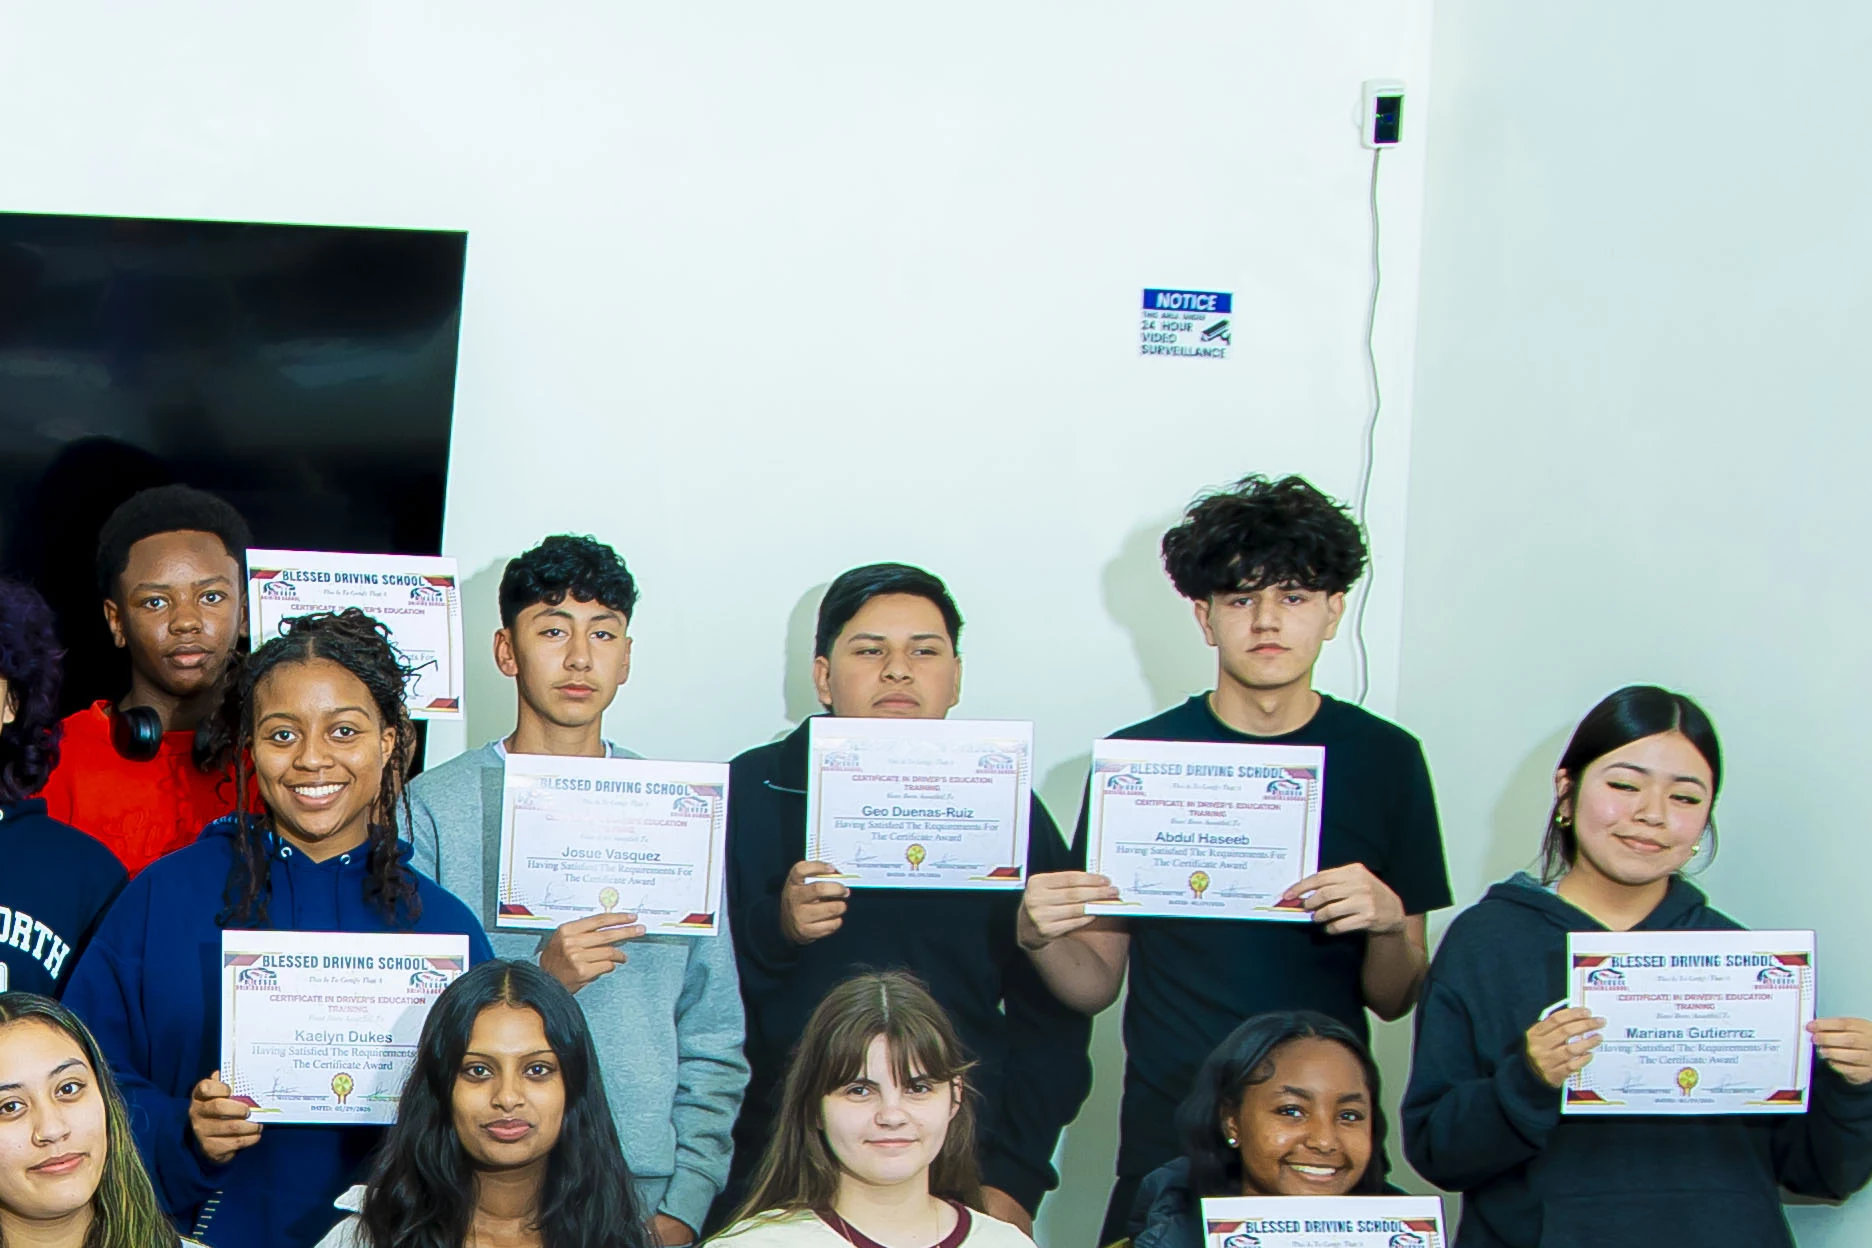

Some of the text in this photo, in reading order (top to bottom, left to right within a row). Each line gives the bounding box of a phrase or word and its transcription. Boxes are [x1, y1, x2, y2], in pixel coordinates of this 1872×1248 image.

[1156, 292, 1218, 310] NOTICE
[1162, 321, 1192, 332] HOUR
[1142, 332, 1177, 343] VIDEO
[1141, 344, 1226, 358] SURVEILLANCE
[282, 570, 425, 586] BLESSED DRIVING SCHOOL
[1130, 763, 1285, 779] BLESSED DRIVING SCHOOL
[539, 778, 691, 796] BLESSED DRIVING SCHOOL
[862, 806, 974, 818] Geo Duenas-Ruiz
[1155, 831, 1250, 845] Abdul Haseeb
[606, 848, 661, 864] Vasquez
[262, 955, 428, 971] BLESSED DRIVING SCHOOL
[1611, 954, 1775, 968] BLESSED DRIVING SCHOOL
[348, 1031, 393, 1043] Dukes
[1626, 1027, 1755, 1039] Mariana Gutierrez
[1246, 1220, 1405, 1233] BLESSED DRIVING SCHOOL
